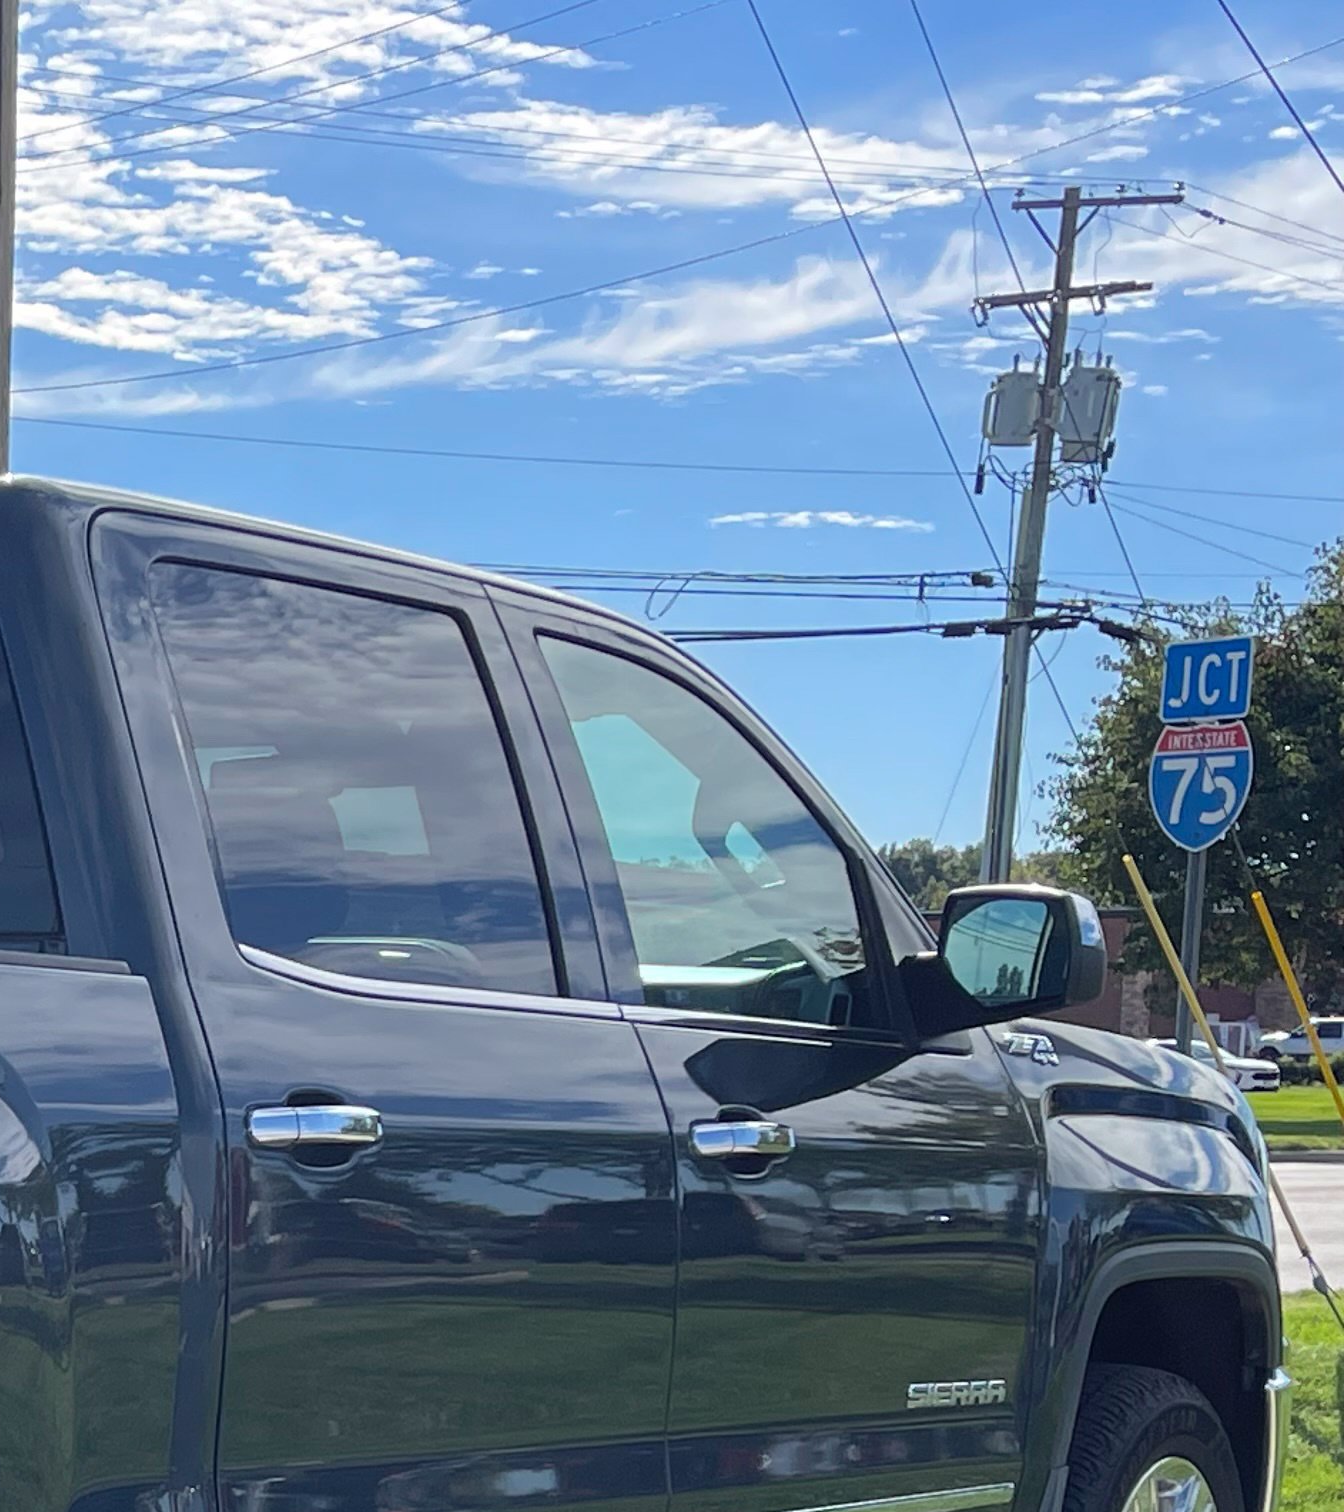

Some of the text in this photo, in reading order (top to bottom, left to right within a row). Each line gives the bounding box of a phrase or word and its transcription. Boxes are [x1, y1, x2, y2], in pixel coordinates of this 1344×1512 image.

[1167, 650, 1246, 708] JCT
[1162, 754, 1237, 825] 75
[906, 1379, 1007, 1409] SIERRA
